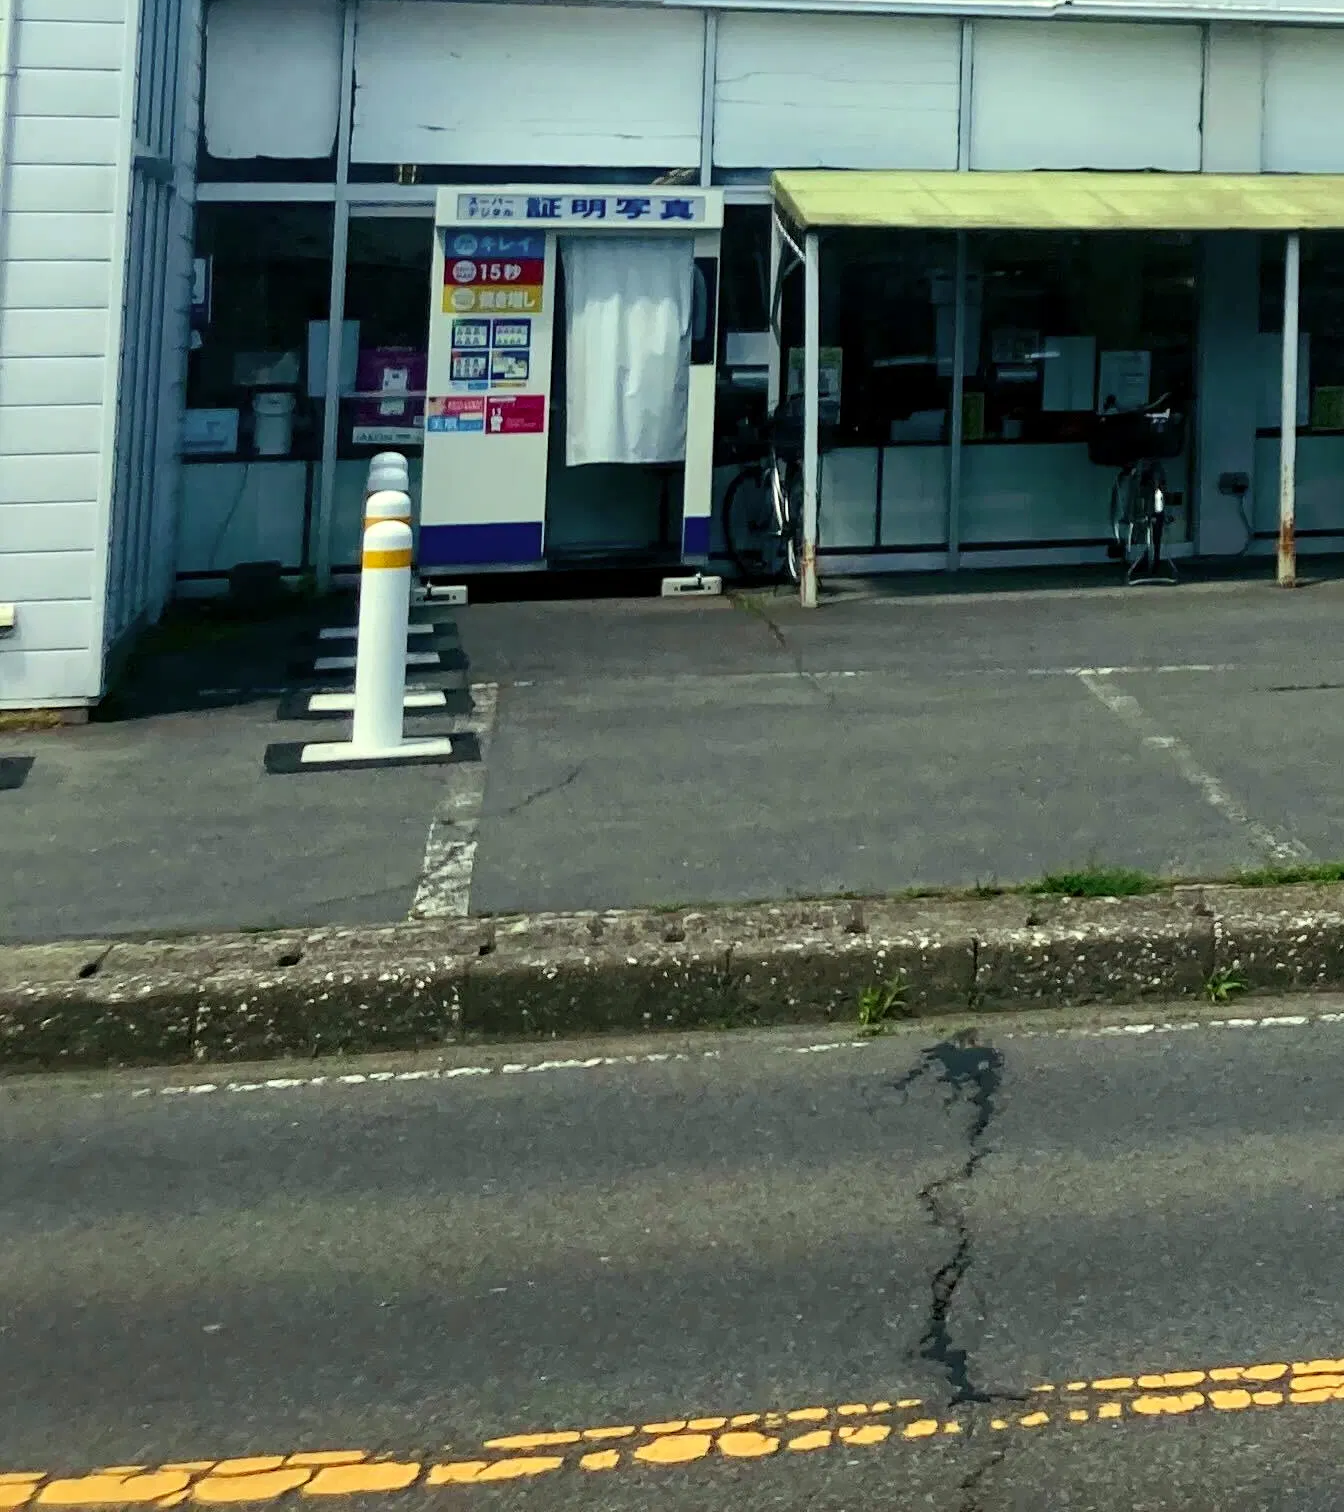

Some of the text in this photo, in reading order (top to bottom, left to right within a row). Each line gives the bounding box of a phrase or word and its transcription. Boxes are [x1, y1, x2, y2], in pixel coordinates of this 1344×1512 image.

[526, 197, 694, 220] 証明写真
[481, 263, 522, 281] 15秒
